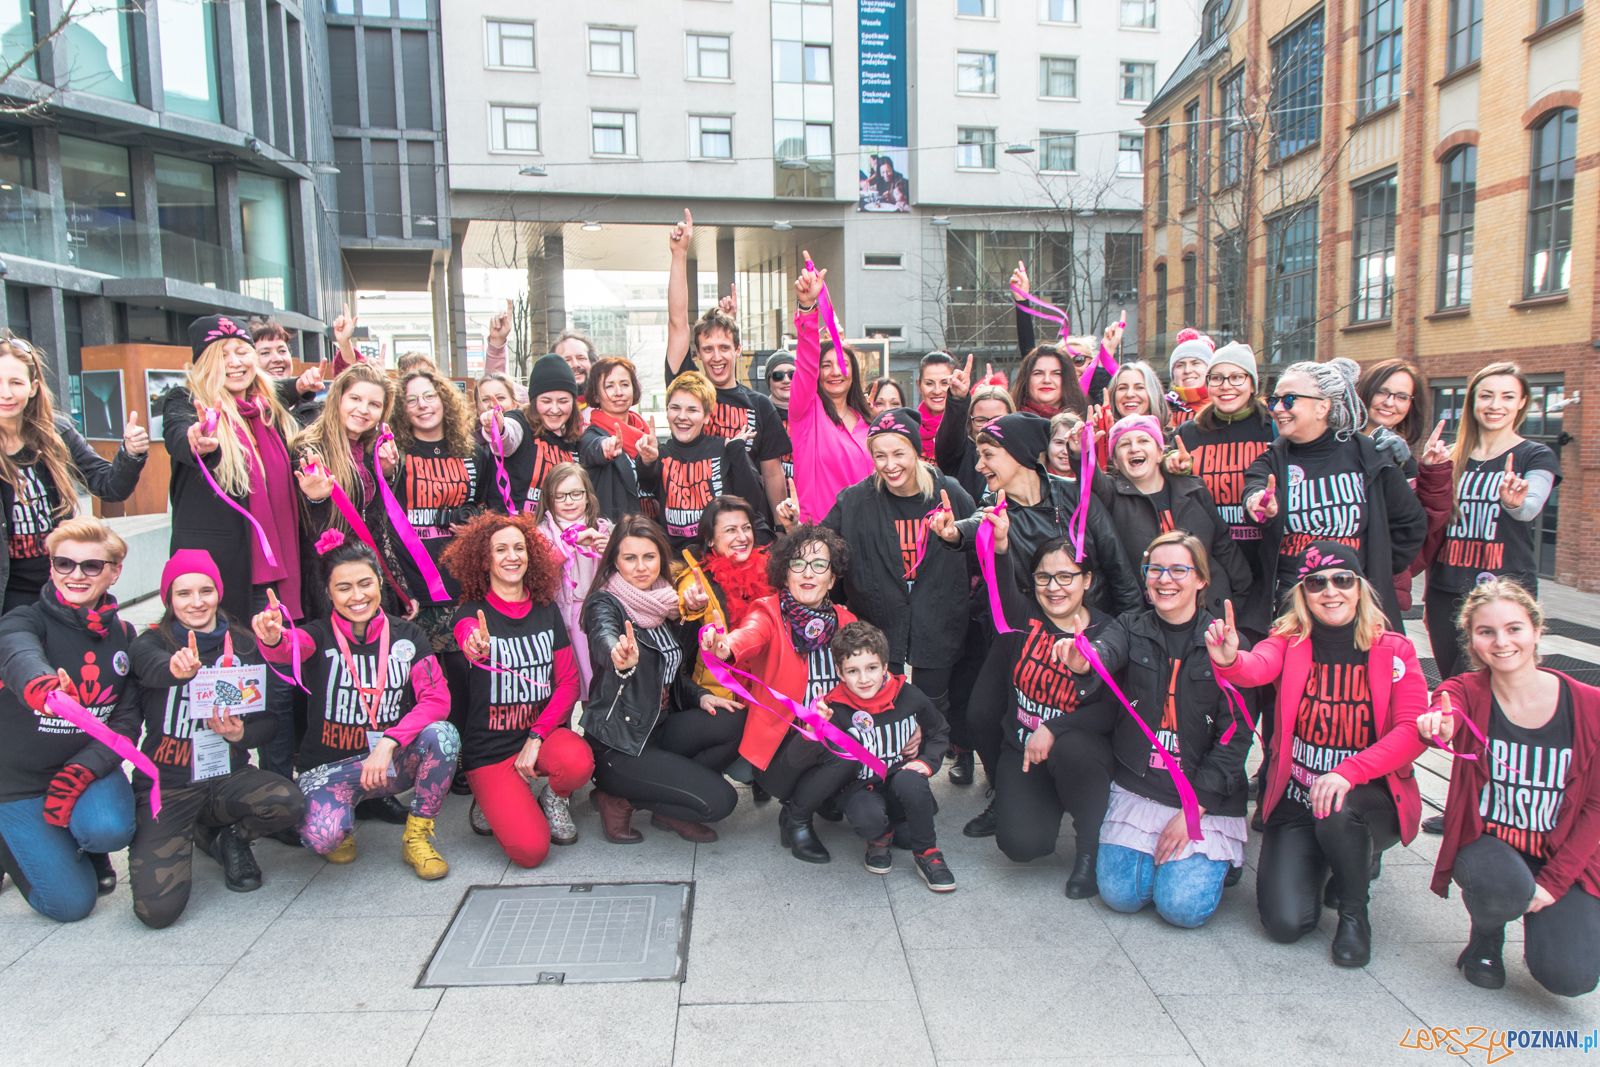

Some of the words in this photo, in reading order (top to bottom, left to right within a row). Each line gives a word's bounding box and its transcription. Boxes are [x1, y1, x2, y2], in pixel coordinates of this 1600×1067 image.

[413, 457, 470, 483] BILLION
[1287, 472, 1367, 512] BILLION
[196, 690, 215, 700] TAK
[1297, 697, 1370, 749] RISING
